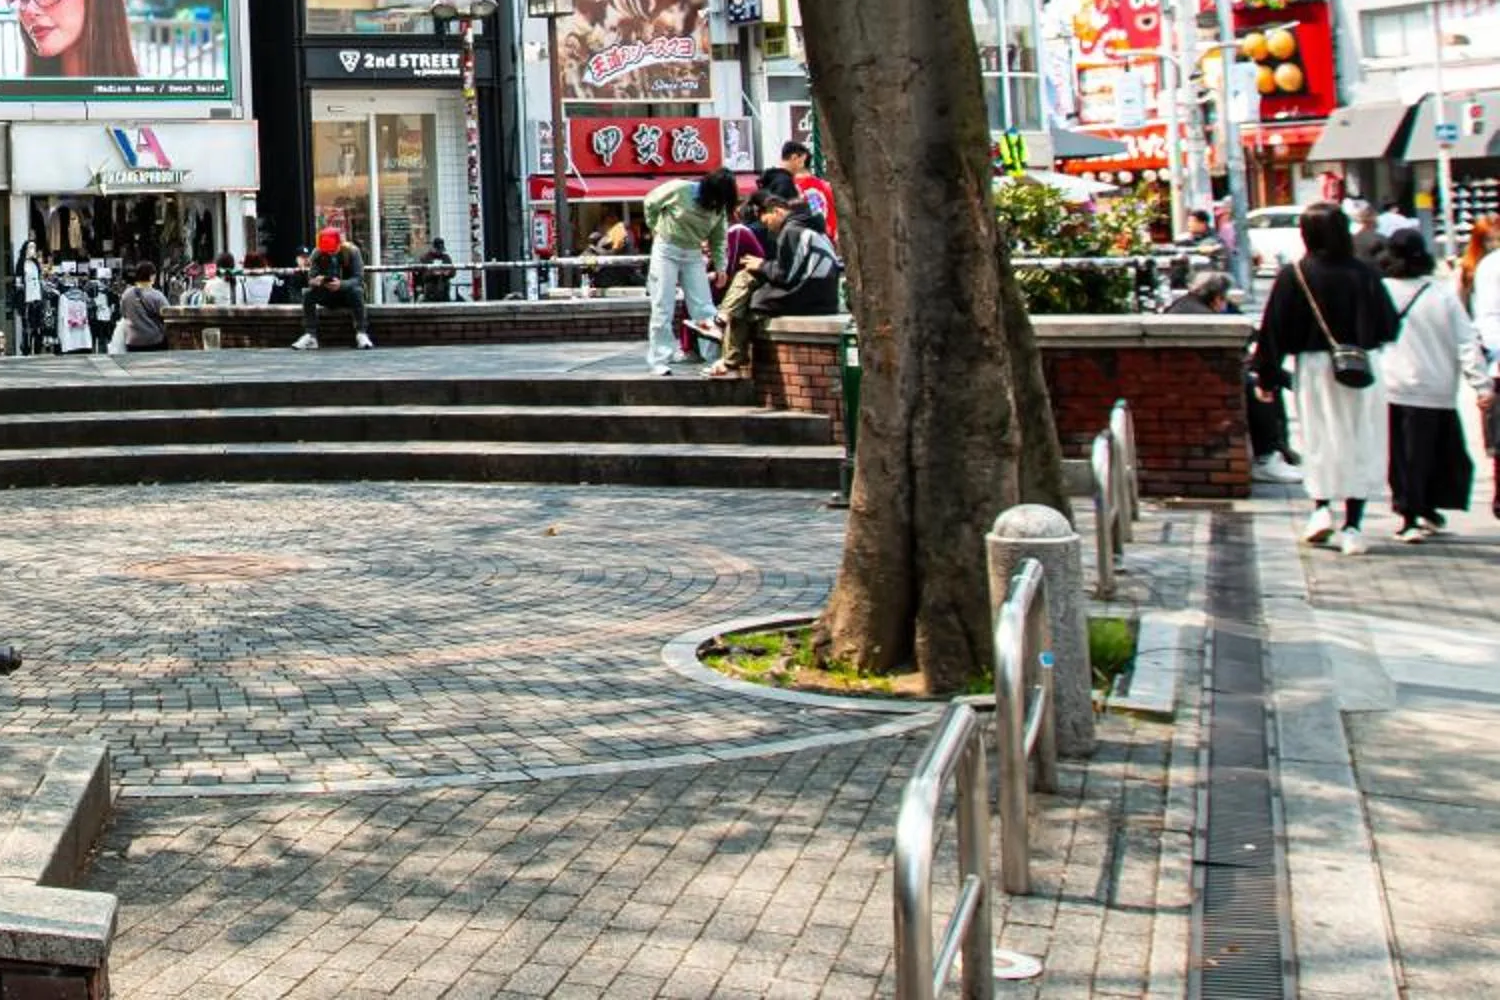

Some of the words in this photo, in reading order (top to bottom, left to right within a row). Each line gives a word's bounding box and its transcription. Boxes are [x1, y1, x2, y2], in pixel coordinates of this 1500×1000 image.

[364, 53, 396, 69] 2nd
[399, 53, 460, 69] STREET
[593, 123, 708, 167] 甲賀流
